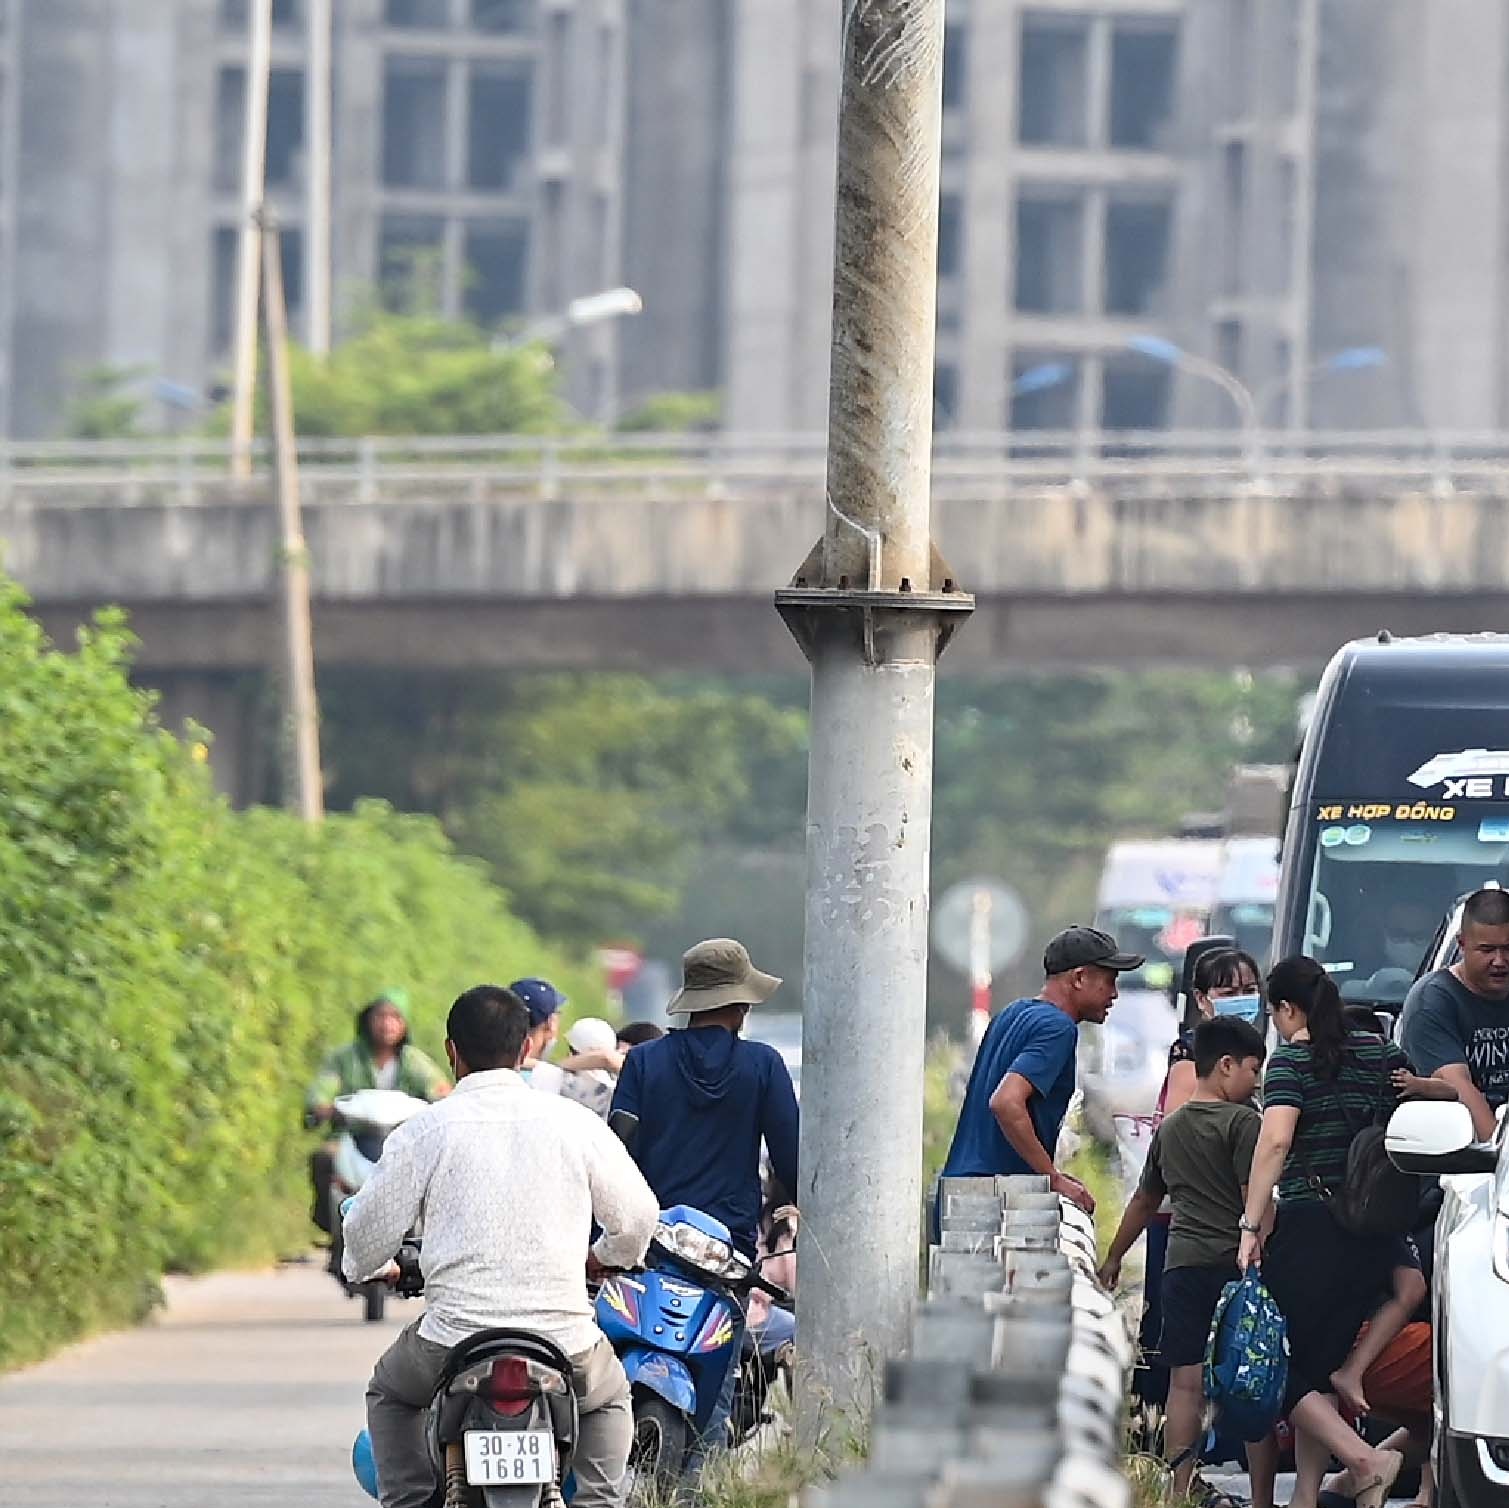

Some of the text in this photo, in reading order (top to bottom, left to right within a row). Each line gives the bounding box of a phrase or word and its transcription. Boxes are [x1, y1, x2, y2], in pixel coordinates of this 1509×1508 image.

[1442, 777, 1493, 799] XE
[1316, 804, 1344, 821] XE
[481, 1458, 540, 1480] 1681
